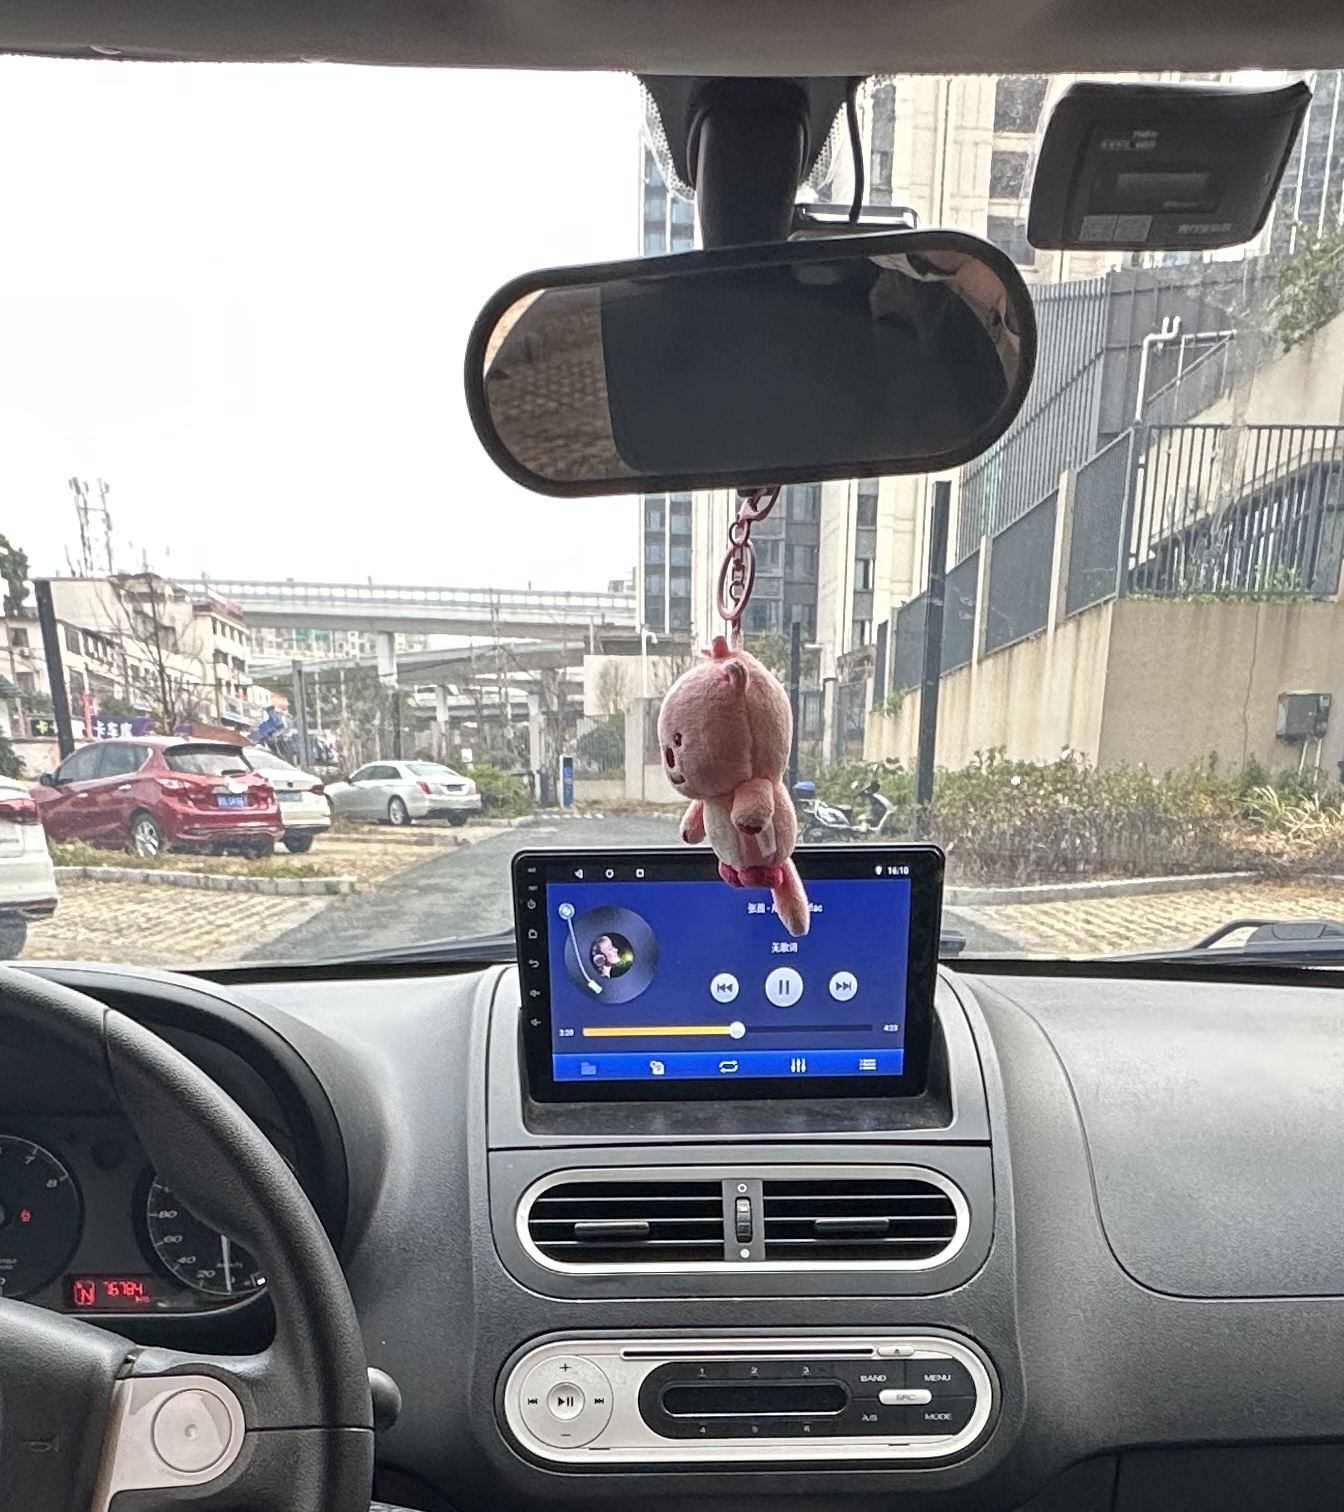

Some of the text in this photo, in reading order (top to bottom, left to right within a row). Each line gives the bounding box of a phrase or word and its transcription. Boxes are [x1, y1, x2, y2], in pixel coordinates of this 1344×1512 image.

[860, 1374, 887, 1383] BAND
[923, 1373, 952, 1382] MENU
[924, 1412, 953, 1421] MODE
